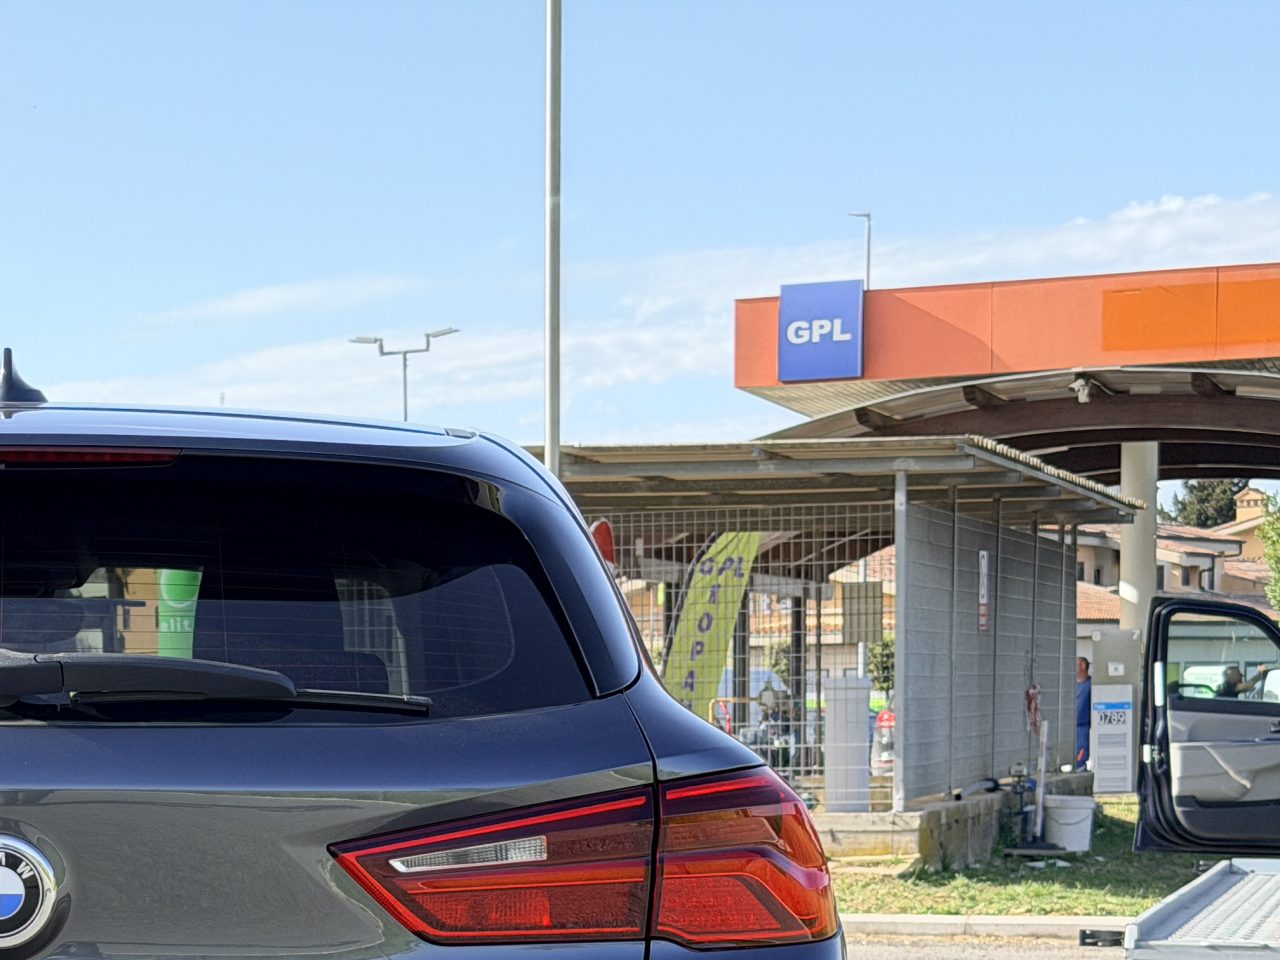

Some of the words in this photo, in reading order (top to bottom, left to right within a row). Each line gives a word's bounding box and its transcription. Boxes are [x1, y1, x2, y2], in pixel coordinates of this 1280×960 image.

[786, 318, 852, 345] GPL
[699, 556, 745, 579] GPL
[1098, 711, 1126, 725] 0789
